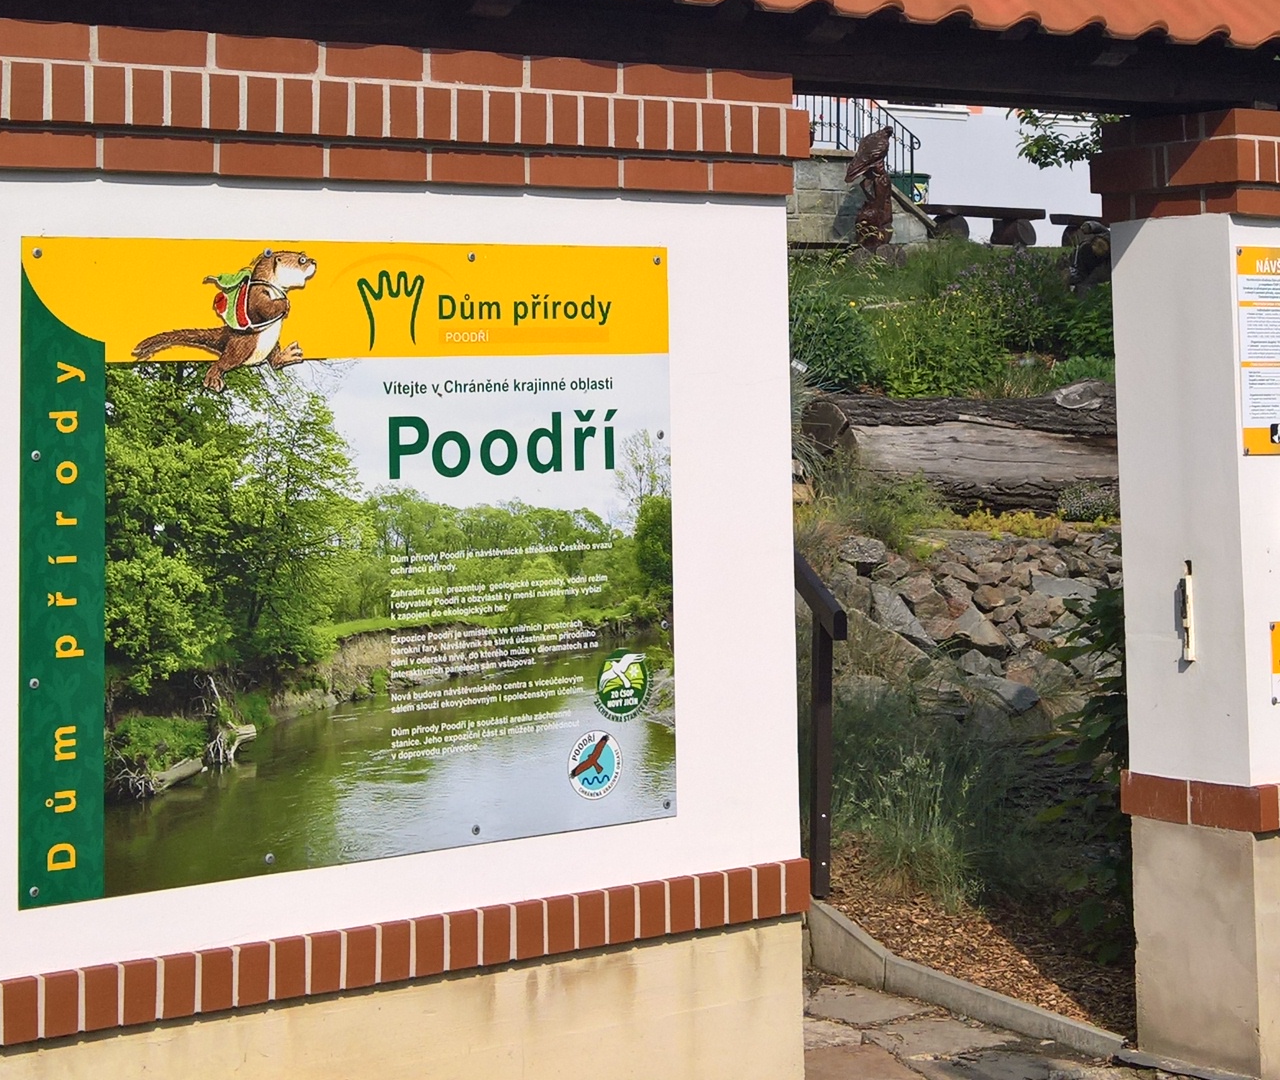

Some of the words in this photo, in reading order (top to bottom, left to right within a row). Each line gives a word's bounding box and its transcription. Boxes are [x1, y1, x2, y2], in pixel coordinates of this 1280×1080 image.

[439, 294, 501, 320] Dům
[514, 294, 611, 326] přírody
[446, 330, 489, 342] POODŘÍ
[383, 381, 427, 398] Vítejte
[432, 384, 439, 393] v
[444, 379, 509, 393] Chráněné
[514, 378, 566, 394] krajinné
[570, 377, 613, 391] oblasti
[388, 409, 618, 480] Poodří
[47, 362, 86, 658] přírody
[390, 555, 408, 563] Dům
[411, 552, 438, 563] přírody
[440, 550, 464, 559] Poodří
[466, 551, 473, 560] je
[476, 546, 523, 558] návštěvnické
[525, 544, 558, 554] středisko
[560, 542, 590, 551] Českého
[390, 564, 426, 575] ochránců
[428, 563, 458, 573] přírody.
[390, 588, 425, 597] Zahradní
[426, 586, 442, 595] část
[447, 583, 485, 594] prezentuje
[489, 580, 529, 591] geologické
[588, 574, 608, 582] režim
[395, 600, 432, 610] obyvatele
[434, 596, 459, 605] Poodří
[467, 593, 503, 603] obzvláště
[513, 590, 535, 599] menší
[537, 588, 579, 597] návštěvníky
[581, 585, 602, 595] vybízí
[397, 610, 430, 620] zapojení
[431, 609, 442, 617] do
[443, 605, 493, 616] ekologických
[391, 634, 426, 645] Expozice
[428, 630, 453, 640] Poodří
[454, 630, 461, 640] je
[463, 627, 497, 638] umístěna
[510, 623, 542, 632] vnitřních
[543, 620, 582, 630] prostorách
[391, 645, 420, 655] barokní
[422, 645, 438, 654] fary.
[441, 640, 481, 651] Návštěvník
[483, 639, 493, 647] se
[494, 636, 514, 646] stává
[515, 633, 557, 644] účastníkem
[559, 630, 596, 641] přírodního
[391, 658, 408, 667] dění
[416, 655, 447, 665] oderské
[449, 653, 467, 662] nivě,
[469, 651, 479, 659] do
[480, 649, 508, 658] kterého
[537, 642, 582, 653] dioramatech
[445, 663, 479, 674] panelech
[481, 661, 496, 669] sám
[498, 657, 536, 668] vstupovat.
[391, 692, 411, 702] Nová
[413, 690, 442, 700] budova
[444, 683, 502, 696] návštěvnického
[504, 681, 526, 690] centra
[535, 675, 584, 686] víceúčelovým
[620, 689, 634, 698] ČSOP
[391, 703, 415, 713] sálem
[416, 699, 439, 711] slouží
[441, 695, 497, 709] ekovýchovným
[503, 691, 555, 702] společenským
[607, 698, 623, 708] NOVÝ
[391, 728, 410, 736] Dům
[411, 725, 439, 736] přírody
[441, 720, 466, 731] Poodří
[467, 720, 475, 730] je
[477, 716, 509, 726] součástí
[510, 714, 533, 723] areálu
[534, 710, 572, 720] záchranné
[391, 739, 421, 749] stanice.
[423, 736, 442, 745] Jeho
[444, 731, 481, 743] expoziční
[482, 729, 498, 737] část
[507, 725, 534, 734] můžete
[536, 720, 580, 733] prohlédnout
[398, 747, 440, 760] doprovodu
[442, 742, 479, 755] průvodce.
[572, 733, 595, 761] POODŘÍ
[45, 725, 76, 871] Dům
